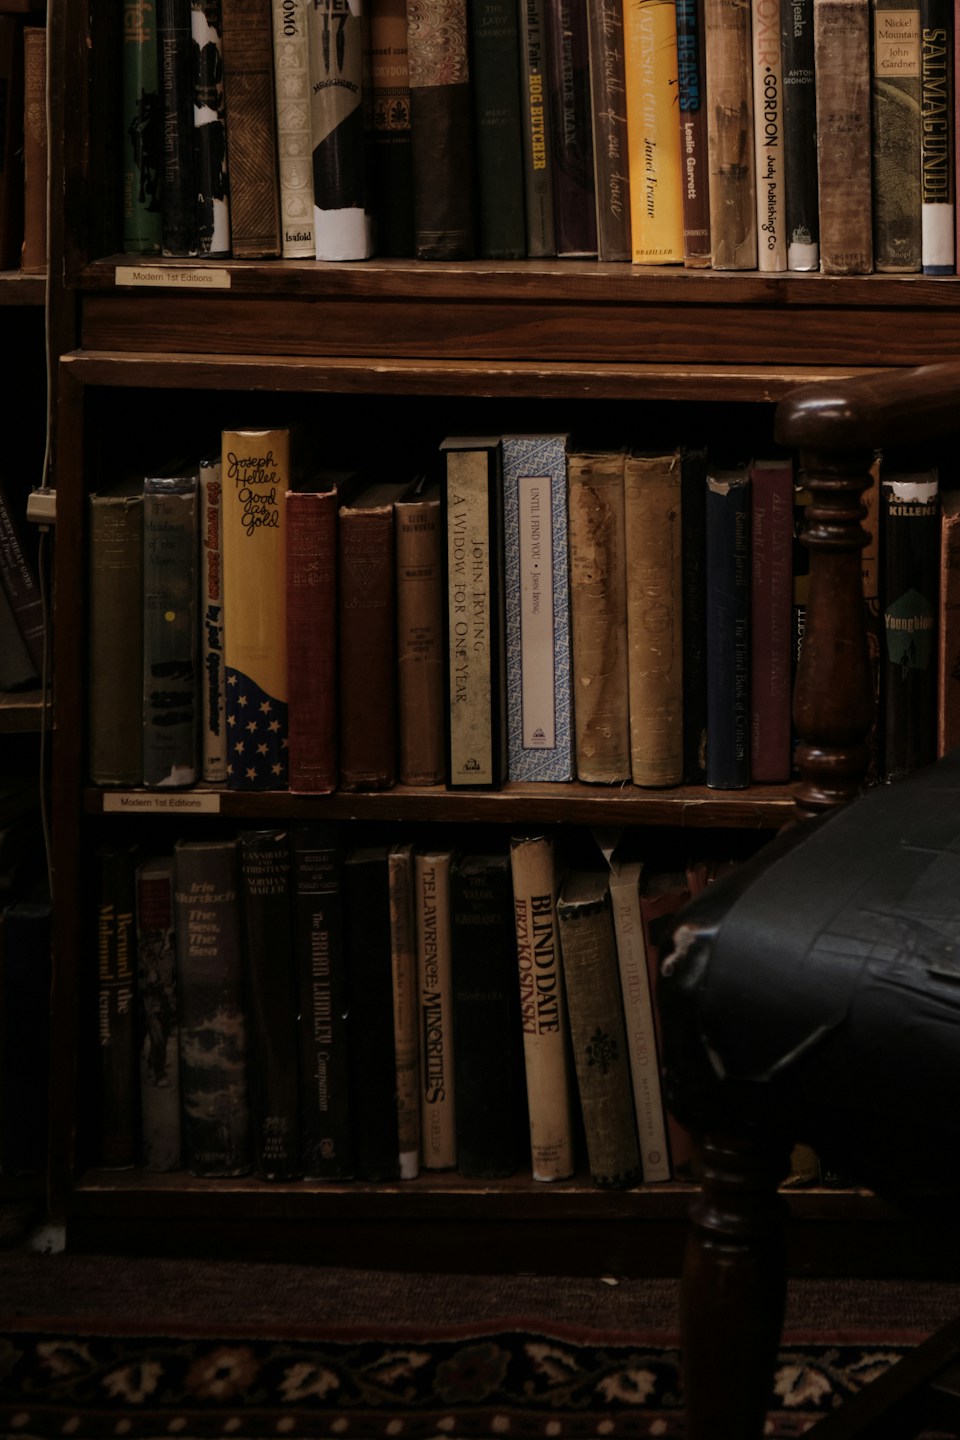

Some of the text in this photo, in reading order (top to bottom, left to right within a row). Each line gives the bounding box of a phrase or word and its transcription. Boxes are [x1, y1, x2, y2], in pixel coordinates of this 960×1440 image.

[885, 19, 912, 27] Nickel
[882, 60, 916, 68] Gardner
[889, 48, 909, 57] John
[678, 34, 700, 110] BEASTS
[529, 74, 543, 104] HOG
[764, 74, 777, 146] GORDON
[530, 109, 546, 170] BUTCHER
[684, 123, 694, 153] Leslie
[132, 273, 212, 283] Modern Editions
[228, 452, 278, 477] Joseph
[236, 469, 280, 486] Heller
[238, 487, 278, 513] Good
[241, 512, 279, 536] Gold
[531, 488, 541, 559] UNTIL YOU
[454, 512, 468, 703] WIDOW FOR YEAR
[472, 540, 486, 652] JOHN IRVING
[121, 799, 201, 808] Modern Editions
[191, 882, 214, 893] Iris
[247, 878, 285, 886] NORMAN
[249, 887, 285, 895] MAILER
[189, 911, 216, 920] The
[188, 946, 217, 956] Sea
[189, 934, 216, 944] The
[515, 900, 537, 1034] JERZY KOSINSKI
[532, 895, 559, 1035] BLIND DATE
[312, 981, 333, 1044] LUMLEY
[423, 991, 444, 1104] MINORITIES
